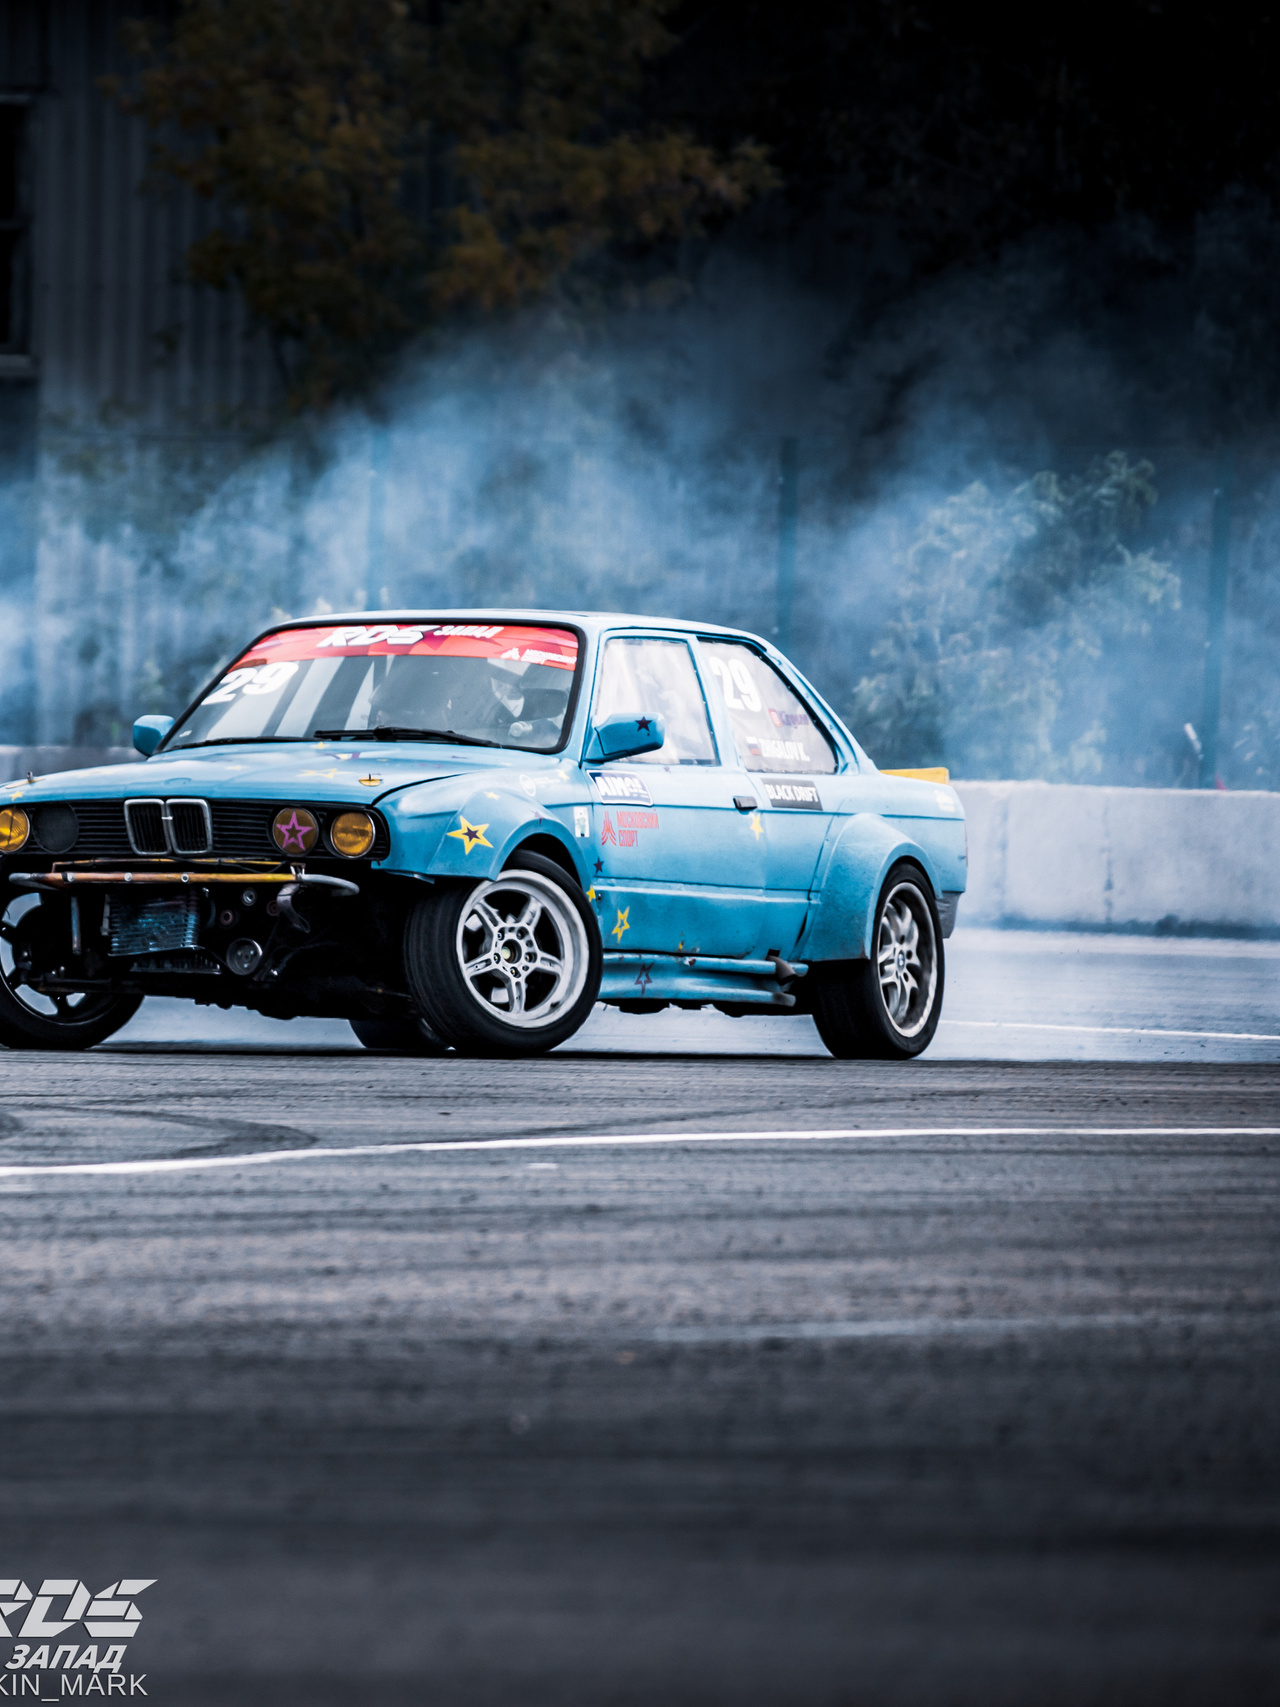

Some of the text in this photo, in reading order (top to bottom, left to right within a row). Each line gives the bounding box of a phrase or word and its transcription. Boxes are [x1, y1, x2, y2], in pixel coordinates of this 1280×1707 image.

[316, 625, 441, 648] RDS
[200, 661, 299, 706] 29
[709, 656, 762, 713] 29
[764, 784, 819, 802] BLACK DRIFT
